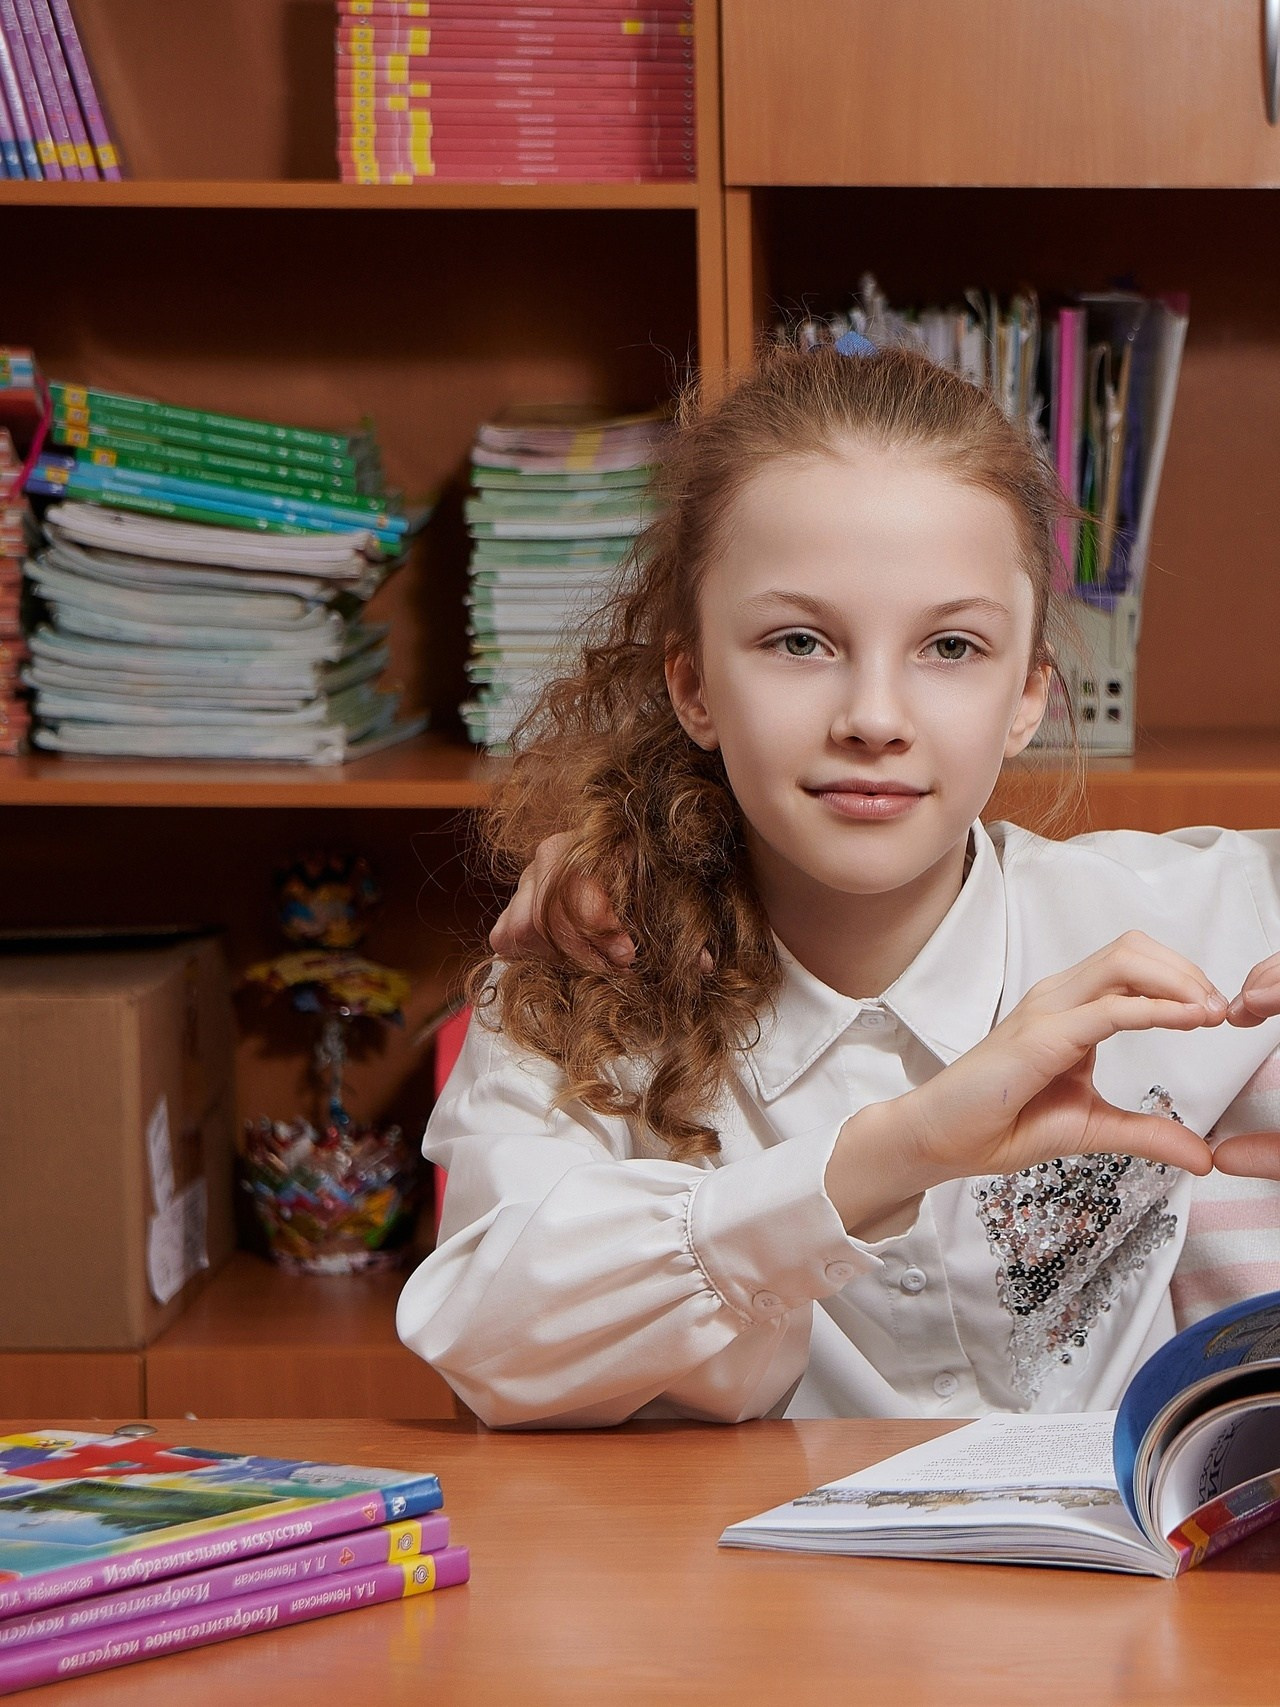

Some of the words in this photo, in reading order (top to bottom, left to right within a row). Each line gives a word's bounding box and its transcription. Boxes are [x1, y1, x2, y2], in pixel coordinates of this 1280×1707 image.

[28, 1575, 94, 1601] Неменская
[102, 1537, 238, 1586] Изобразительное
[240, 1520, 313, 1549] искусство
[234, 1561, 297, 1586] Неменская
[69, 1581, 210, 1627] Изобразительное
[291, 1587, 350, 1611] Неменская
[0, 1616, 64, 1641] искусст
[145, 1603, 279, 1649] Изобразительное
[58, 1640, 140, 1673] искусство
